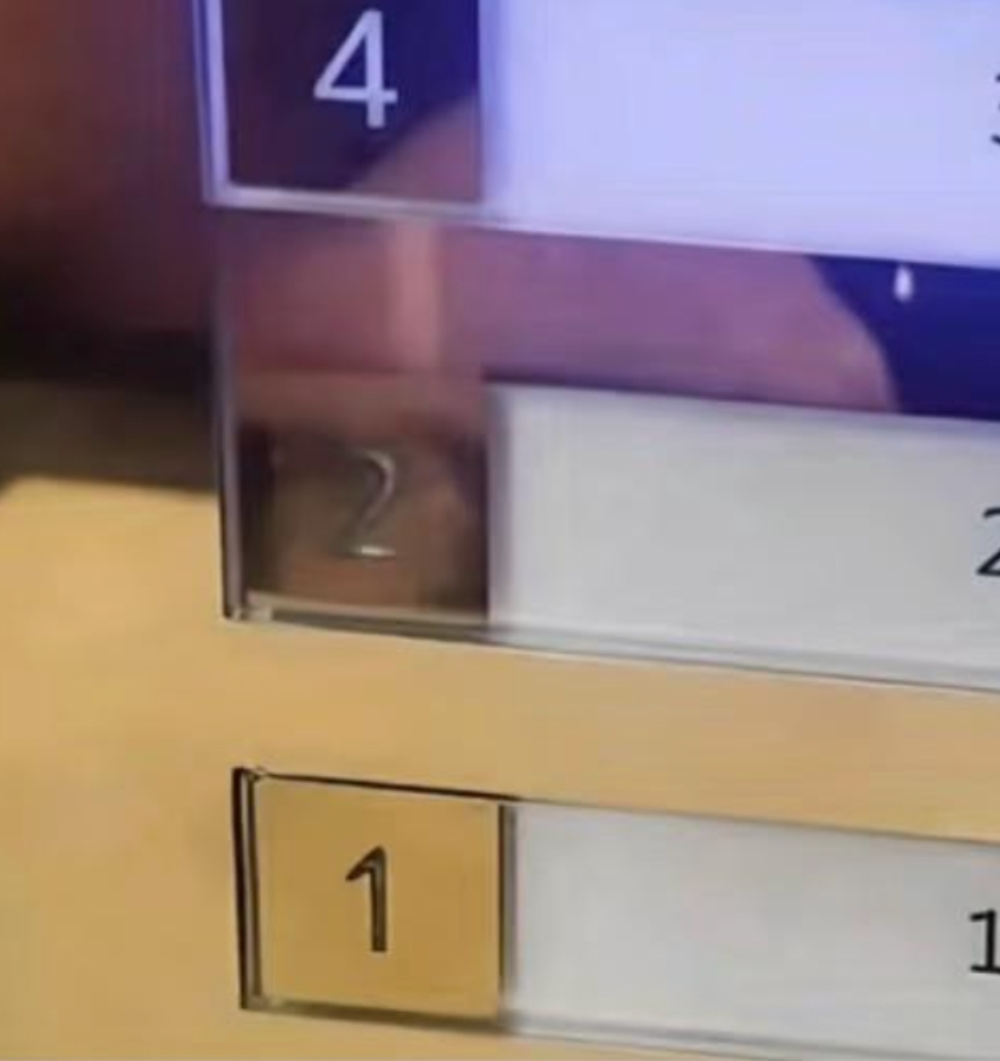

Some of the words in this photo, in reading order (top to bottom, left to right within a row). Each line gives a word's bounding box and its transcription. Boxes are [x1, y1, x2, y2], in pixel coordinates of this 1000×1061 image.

[313, 7, 398, 128] 4
[335, 446, 398, 559] 2
[345, 844, 388, 953] 1
